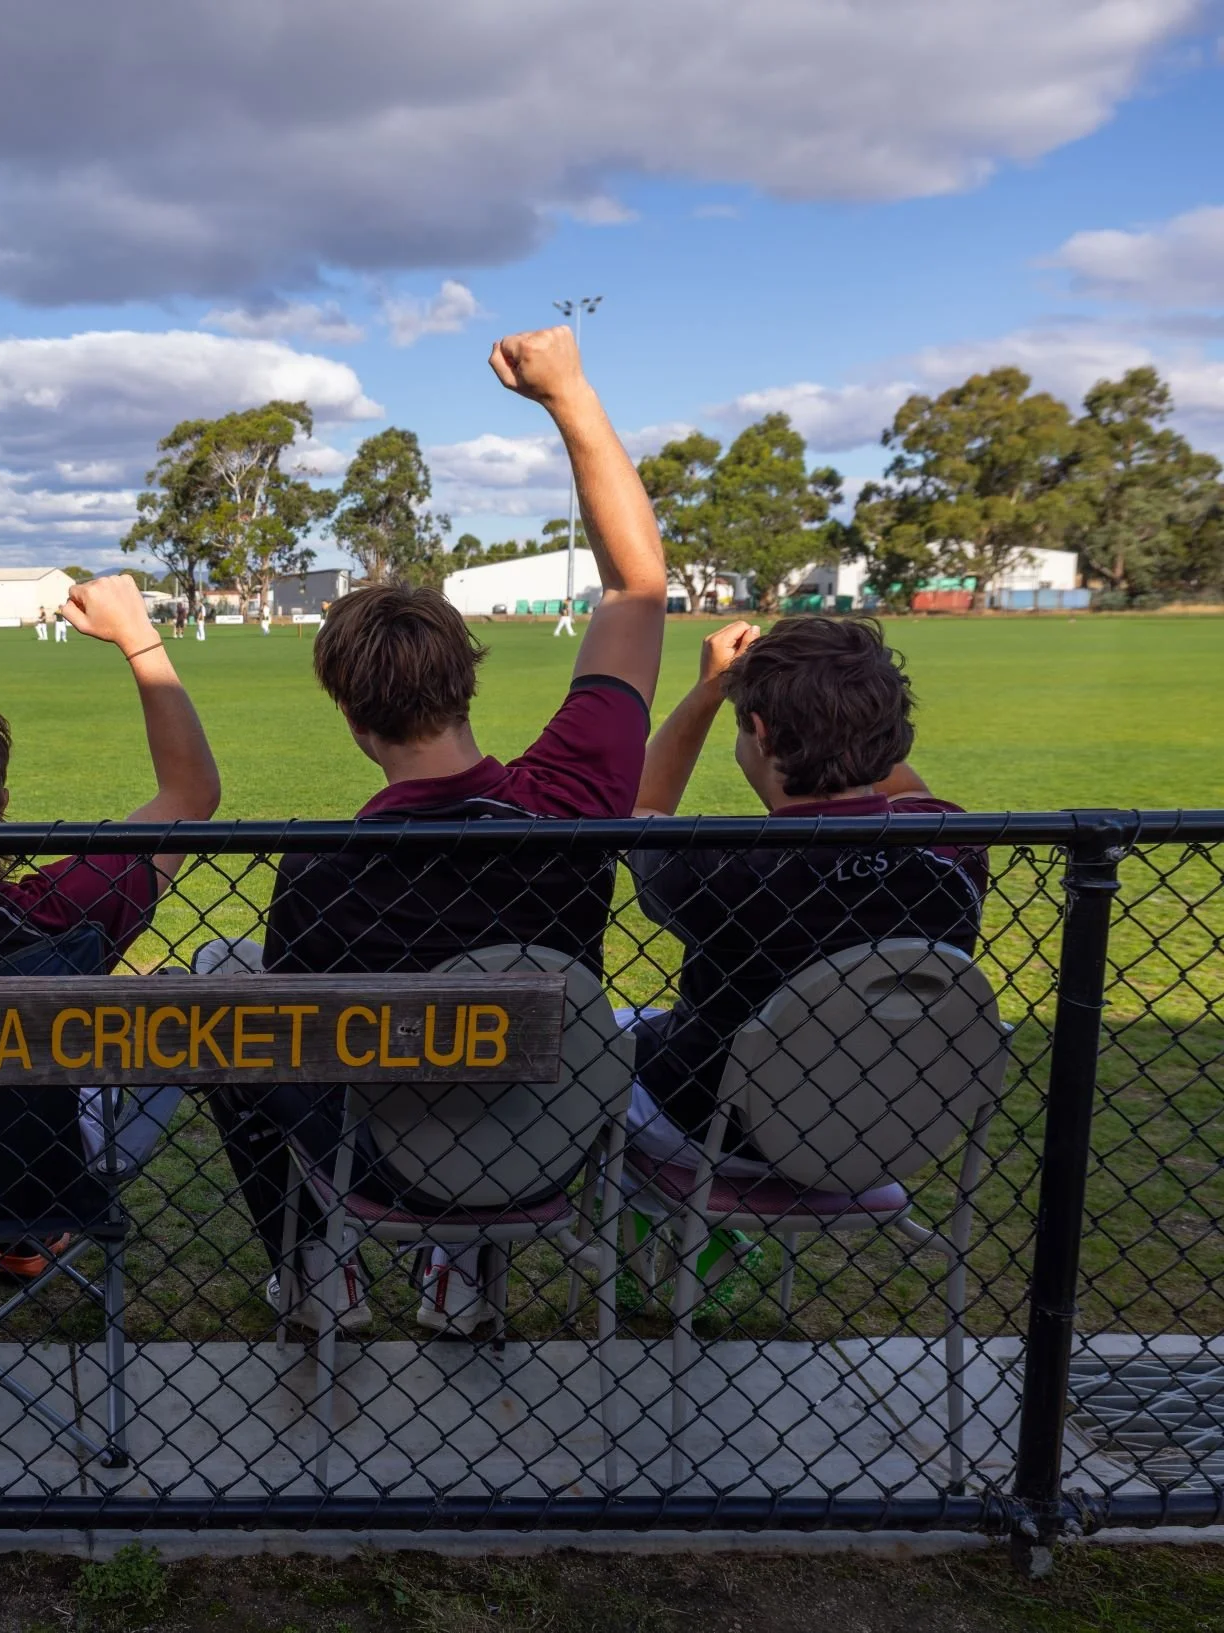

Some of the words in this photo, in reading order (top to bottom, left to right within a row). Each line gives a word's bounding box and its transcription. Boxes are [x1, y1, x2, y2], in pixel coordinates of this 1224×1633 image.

[836, 850, 888, 881] LCS
[51, 1005, 320, 1069] CRICKET
[336, 1004, 510, 1068] CLUB
